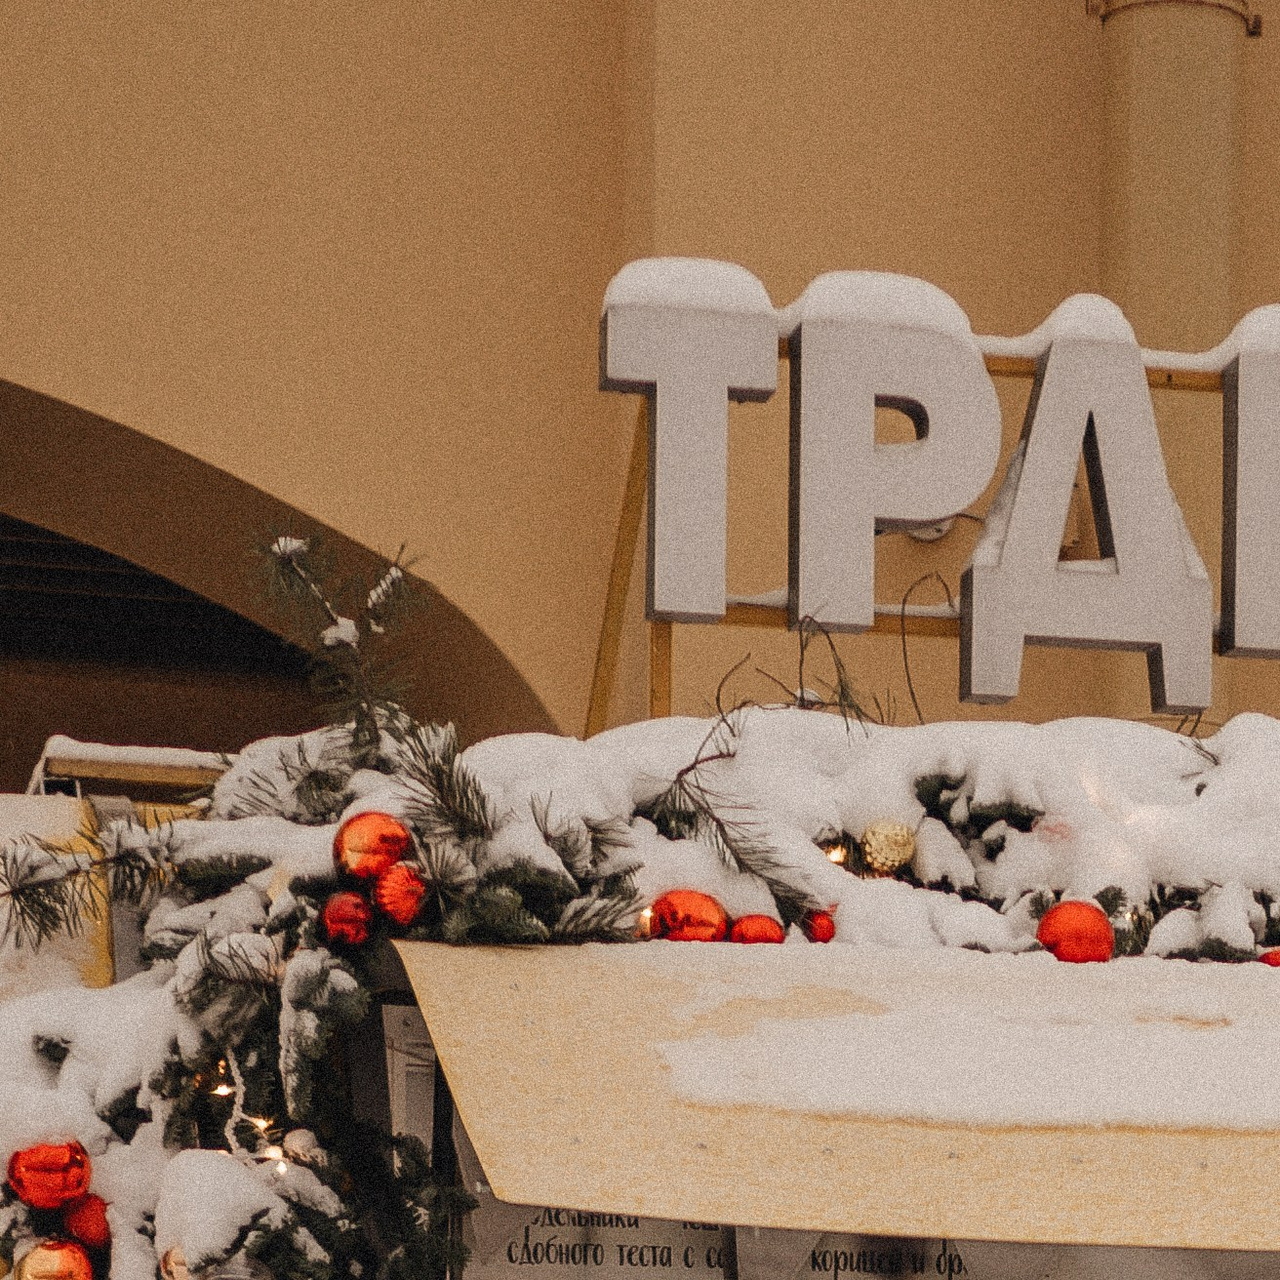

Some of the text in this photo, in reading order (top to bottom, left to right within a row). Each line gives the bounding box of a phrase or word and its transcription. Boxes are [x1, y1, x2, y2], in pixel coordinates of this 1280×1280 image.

[507, 1225, 604, 1266] сдобного
[618, 1244, 672, 1267] теста
[683, 1246, 694, 1268] с
[911, 1254, 925, 1274] и
